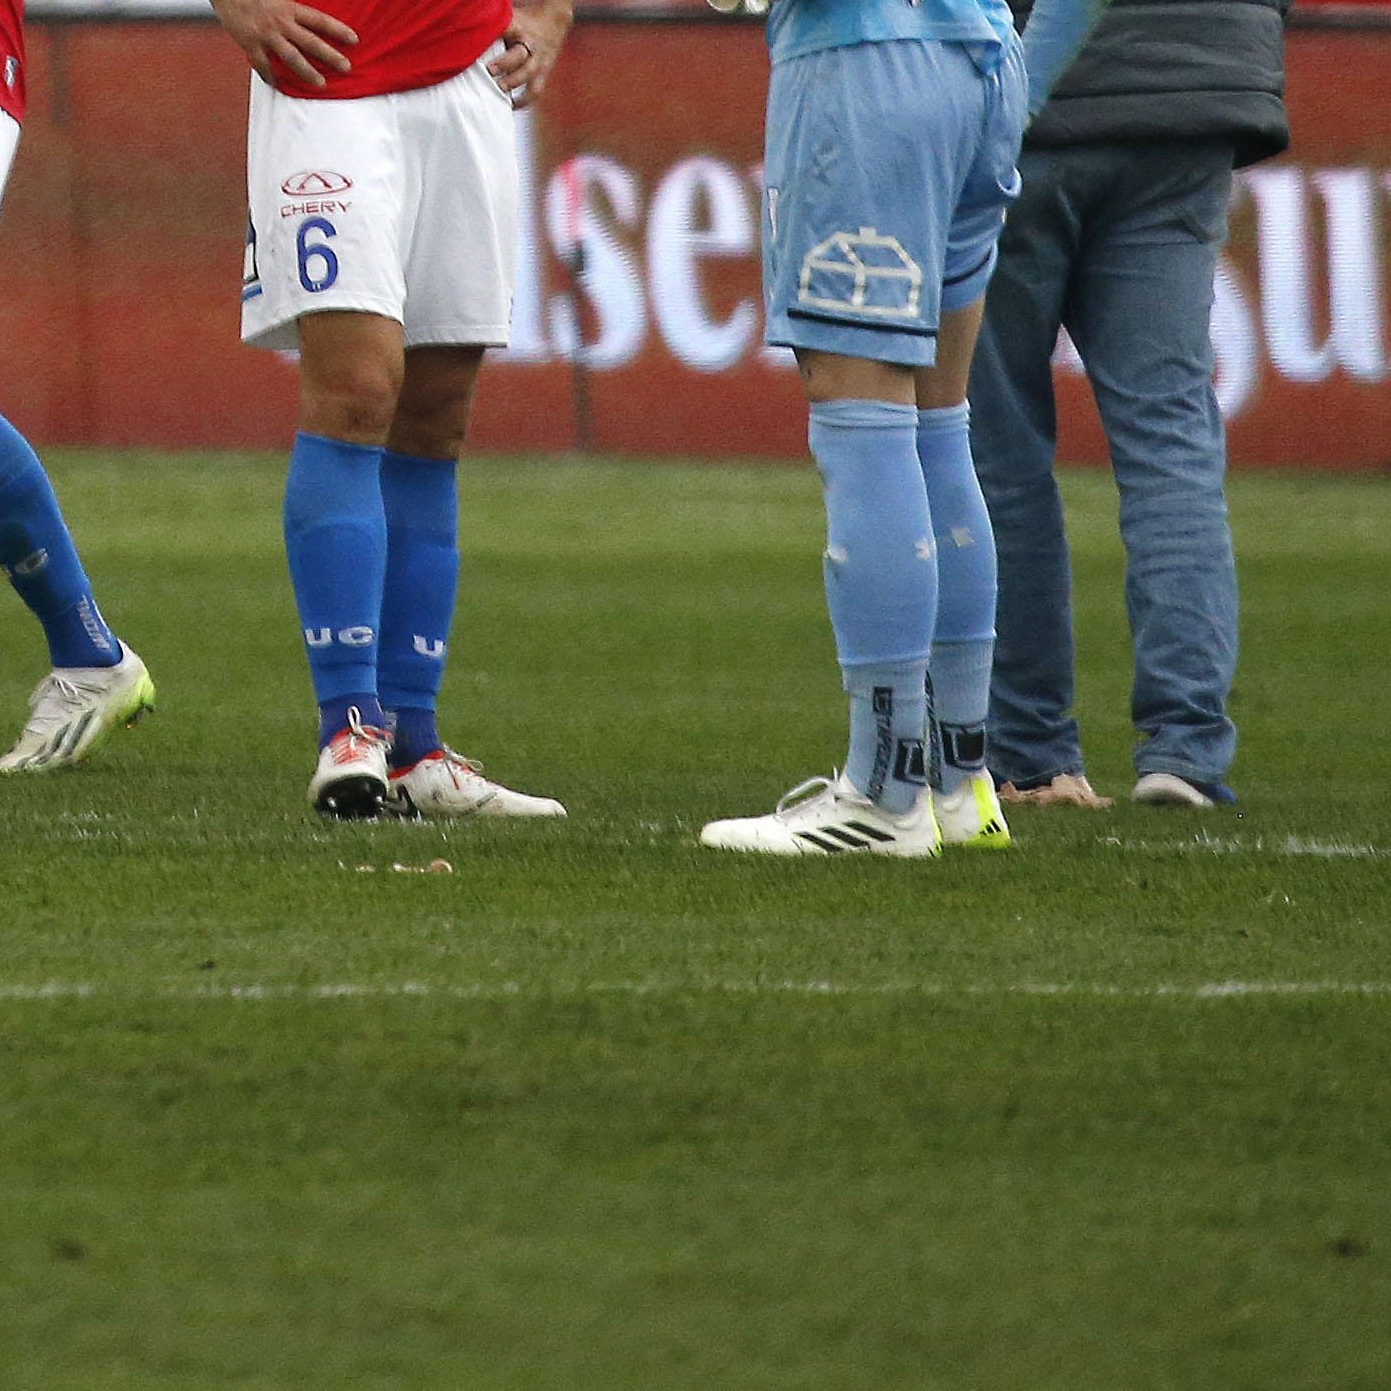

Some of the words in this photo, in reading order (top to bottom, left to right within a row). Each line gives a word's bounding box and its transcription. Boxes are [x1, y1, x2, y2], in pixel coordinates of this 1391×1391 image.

[280, 200, 353, 218] CHERY
[297, 216, 338, 293] 6
[304, 625, 375, 646] UC
